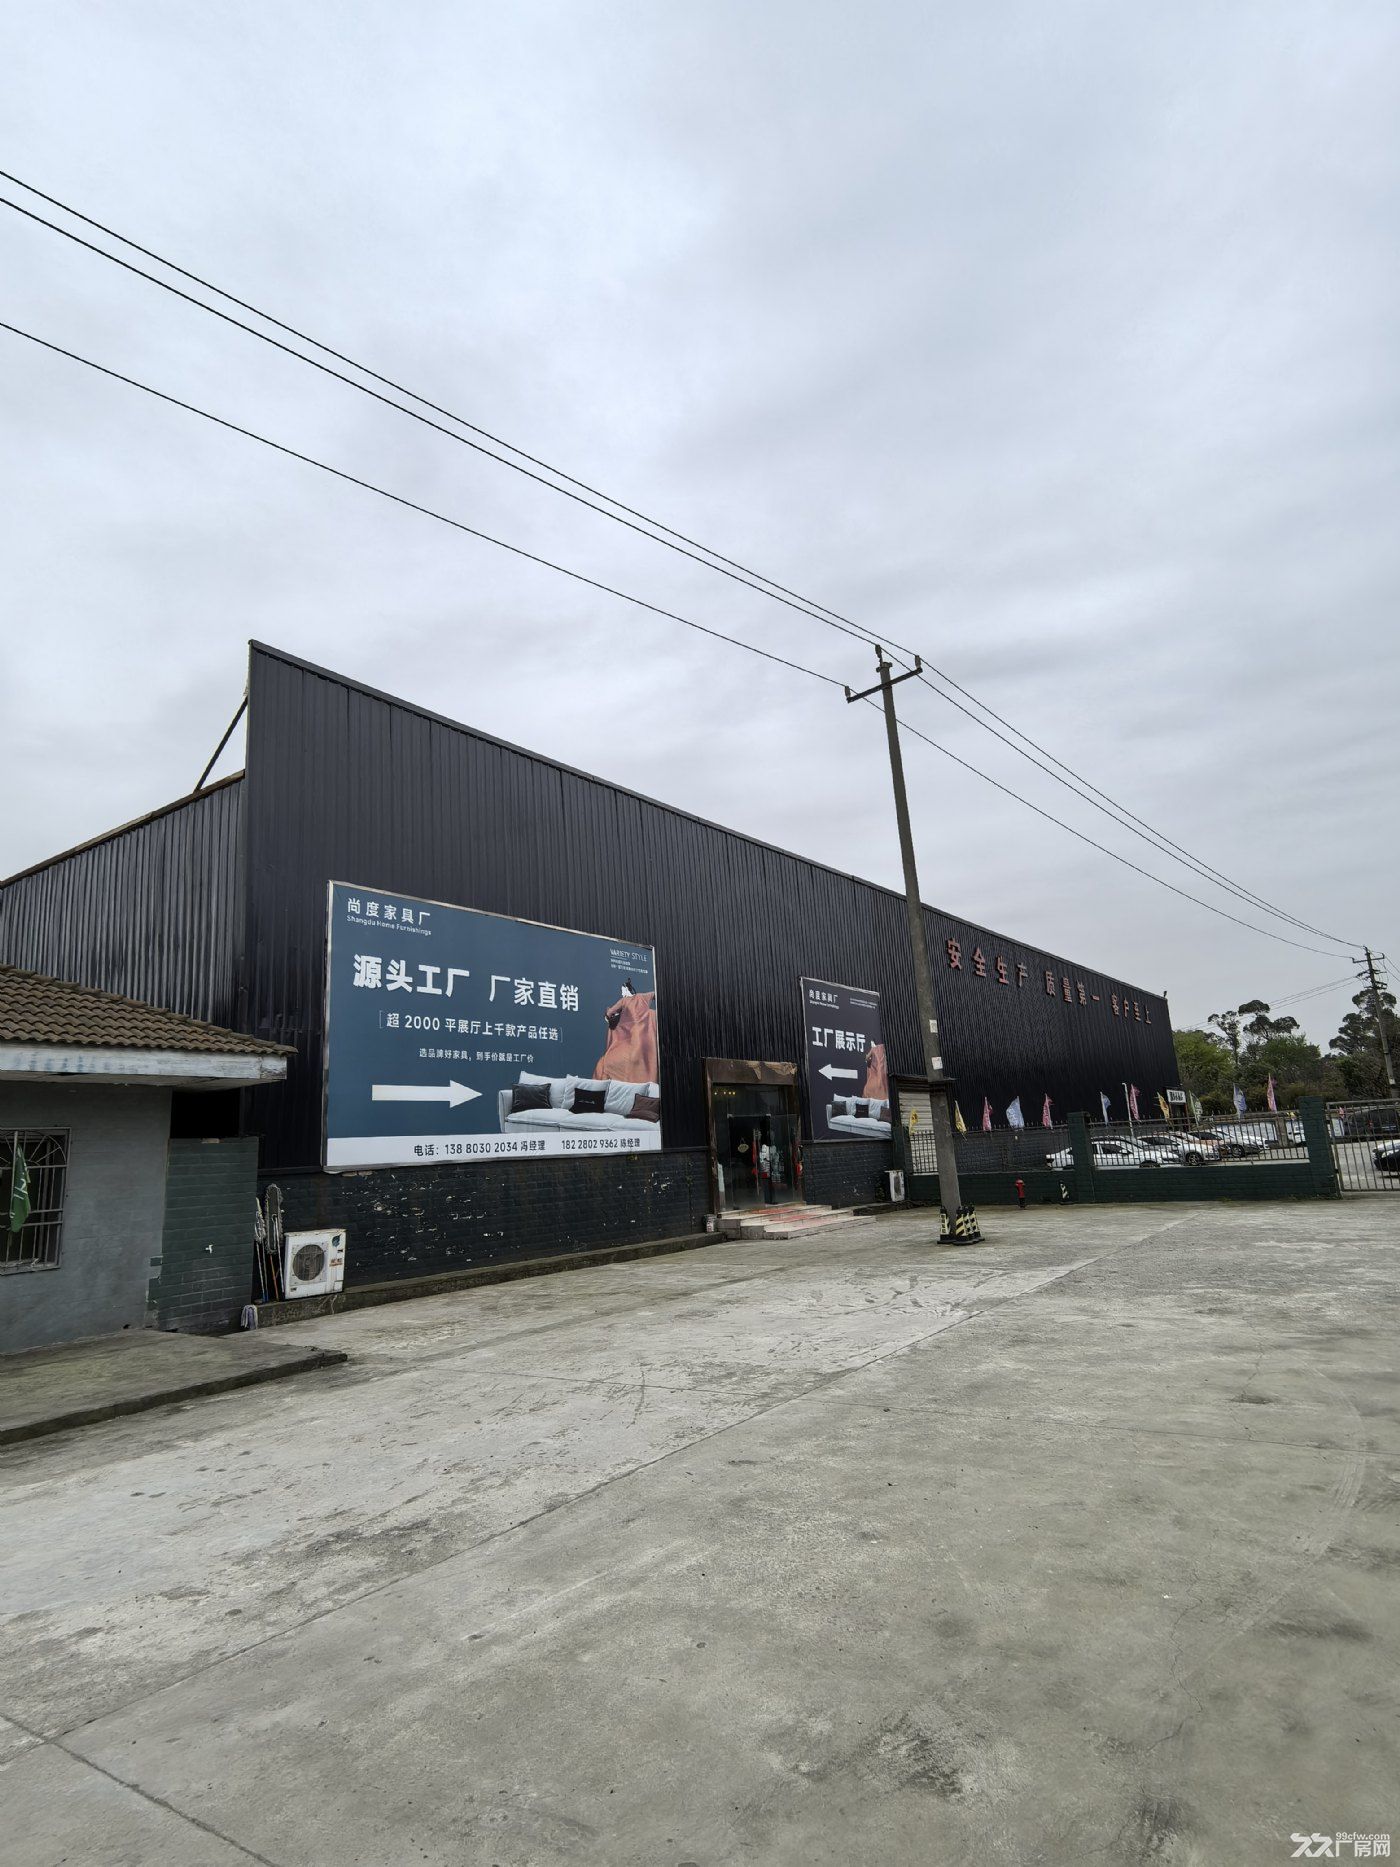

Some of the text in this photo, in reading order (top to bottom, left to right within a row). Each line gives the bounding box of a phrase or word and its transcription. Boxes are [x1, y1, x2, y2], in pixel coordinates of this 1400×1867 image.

[347, 897, 431, 926] 尚度家具厂
[376, 920, 395, 930] Home
[396, 923, 432, 936] Furnishings
[631, 952, 647, 962] STYLE
[352, 953, 579, 1012] 源头工厂 厂家直销
[946, 937, 1028, 987] 安全生产
[1111, 992, 1152, 1024] 客户至上
[386, 1012, 559, 1041] 超 2000 平展厅上千款产品任选
[811, 1026, 866, 1053] 工厂展示厅
[444, 1143, 463, 1155] 138
[465, 1142, 491, 1154] 8030
[494, 1141, 518, 1153] 2034
[561, 1139, 576, 1150] 182
[578, 1139, 598, 1150] 2802
[600, 1138, 618, 1149] 9362
